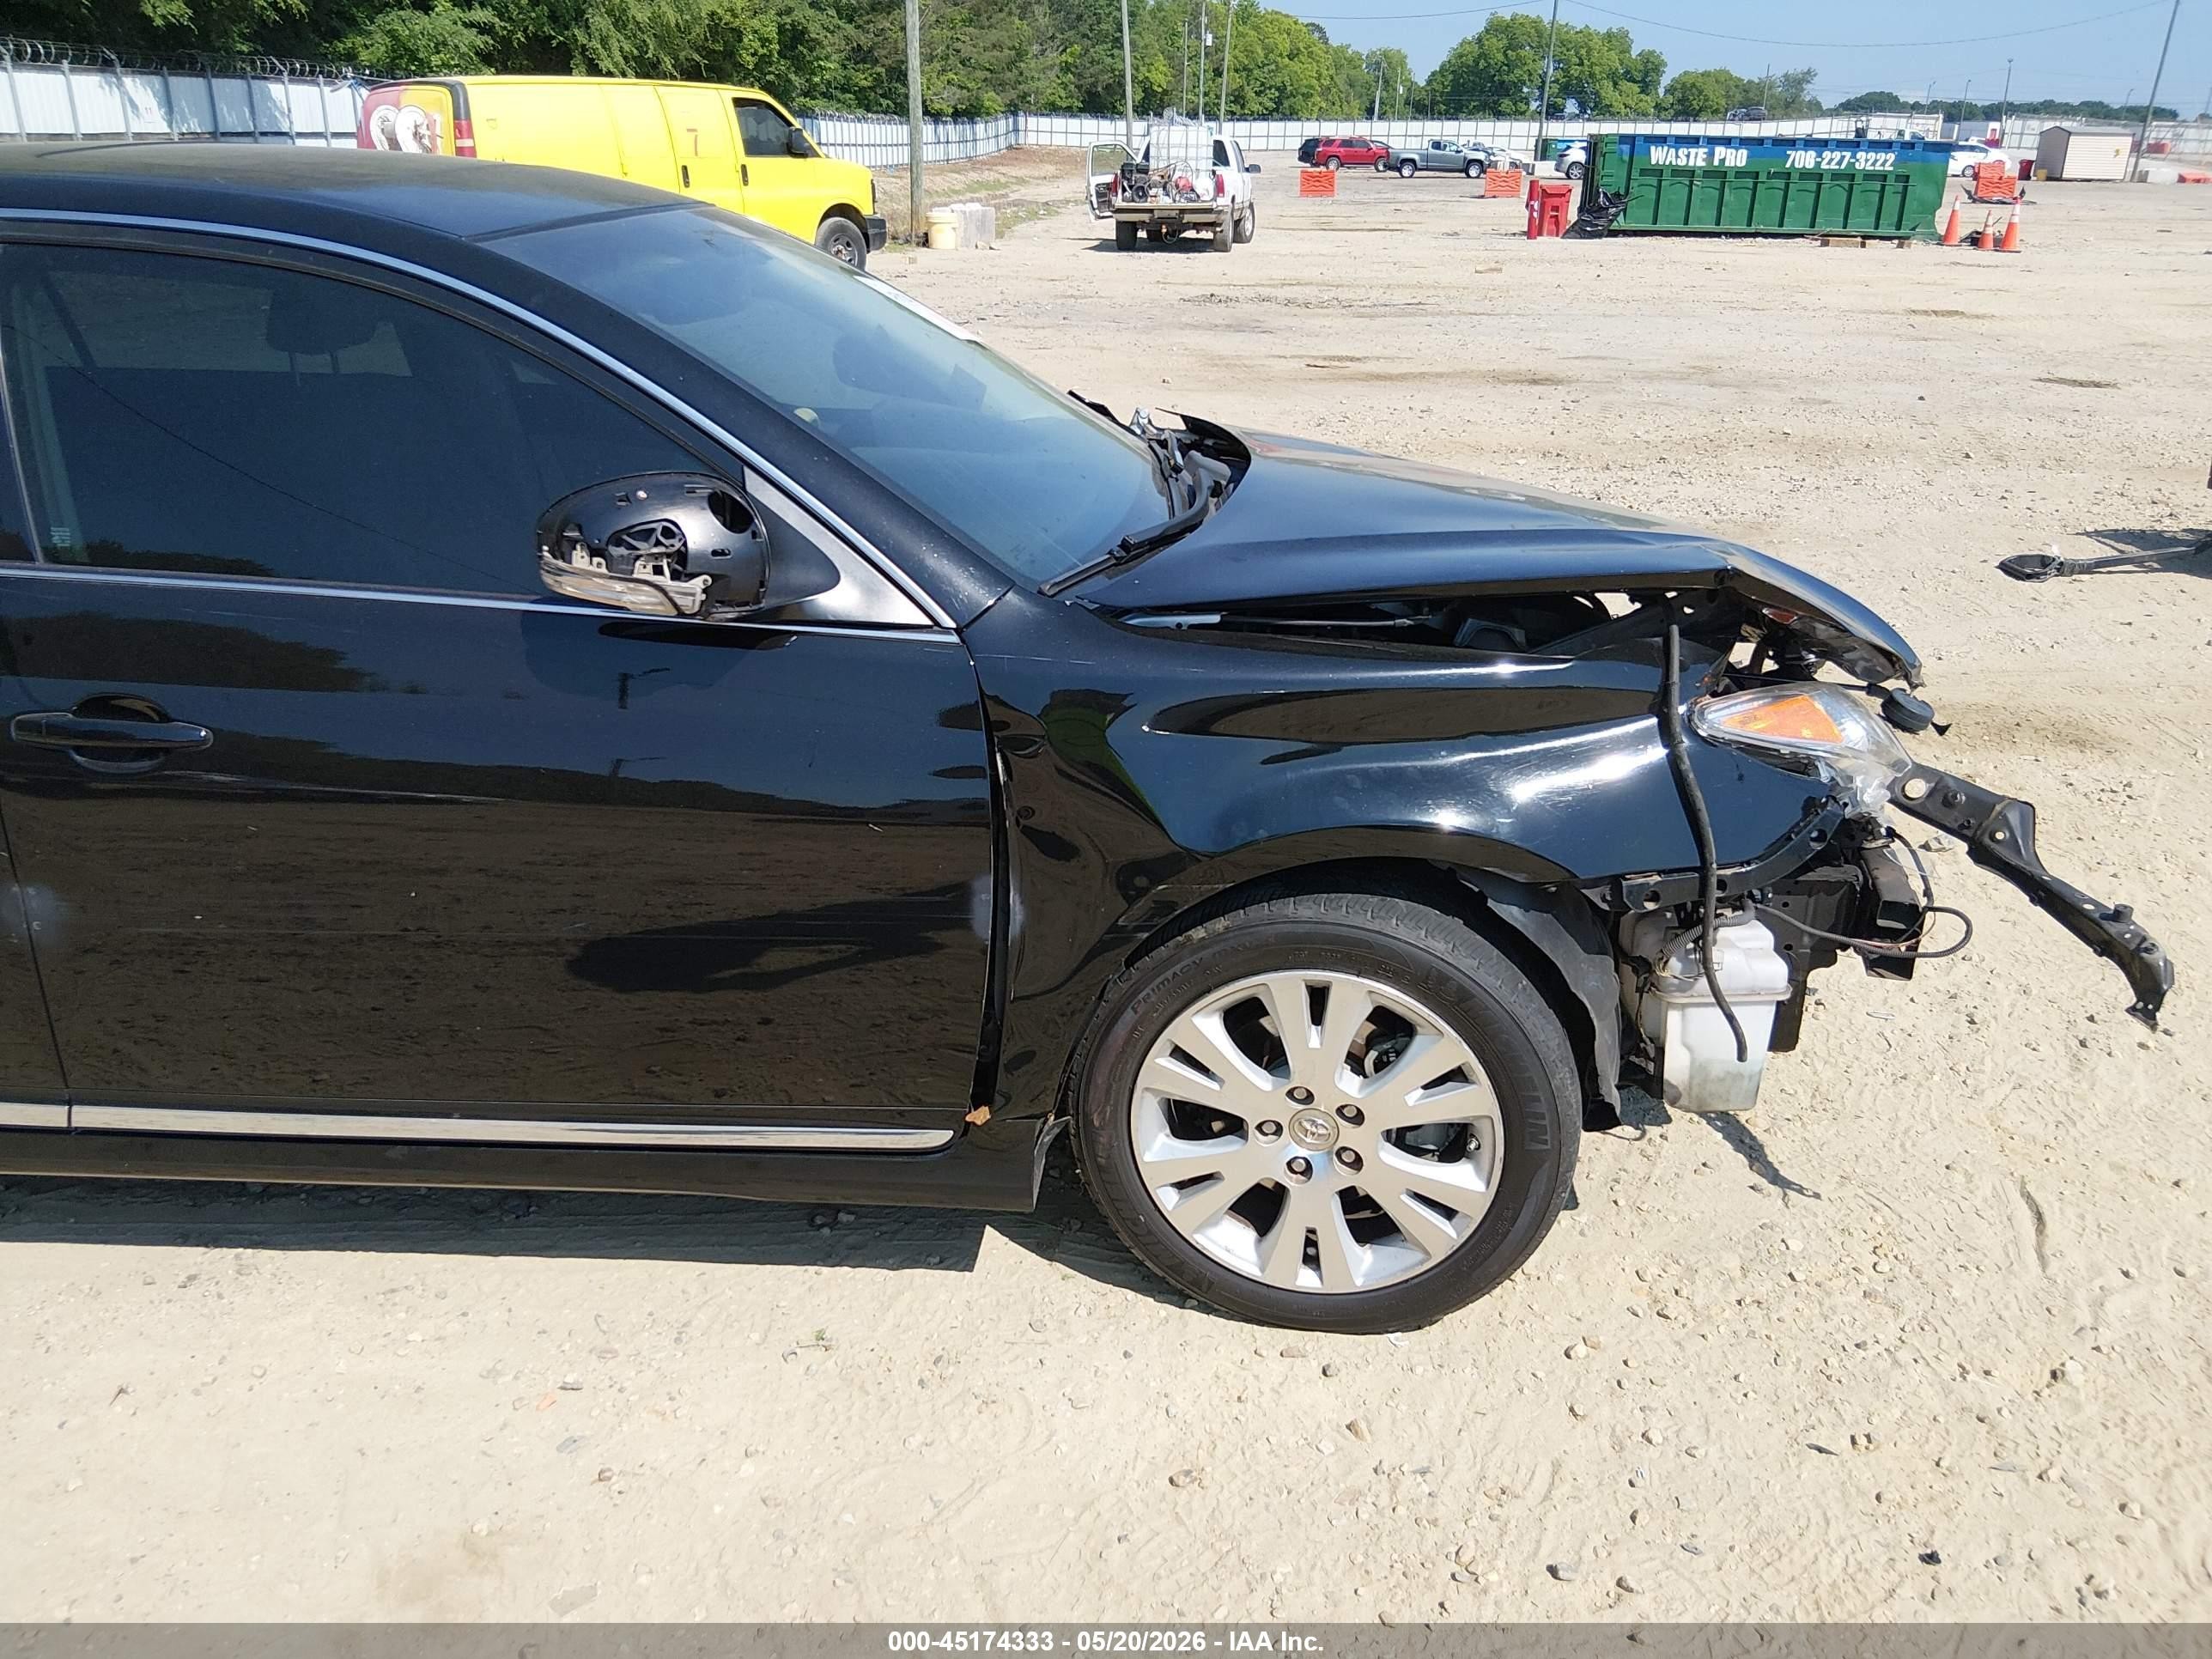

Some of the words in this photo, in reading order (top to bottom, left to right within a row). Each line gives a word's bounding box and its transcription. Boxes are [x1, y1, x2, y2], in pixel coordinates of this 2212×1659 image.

[1650, 145, 1709, 167] WASTE
[1712, 146, 1748, 167] PRO
[1784, 149, 1896, 171] 706-227-3222
[1130, 956, 1206, 1016] PRIMACY
